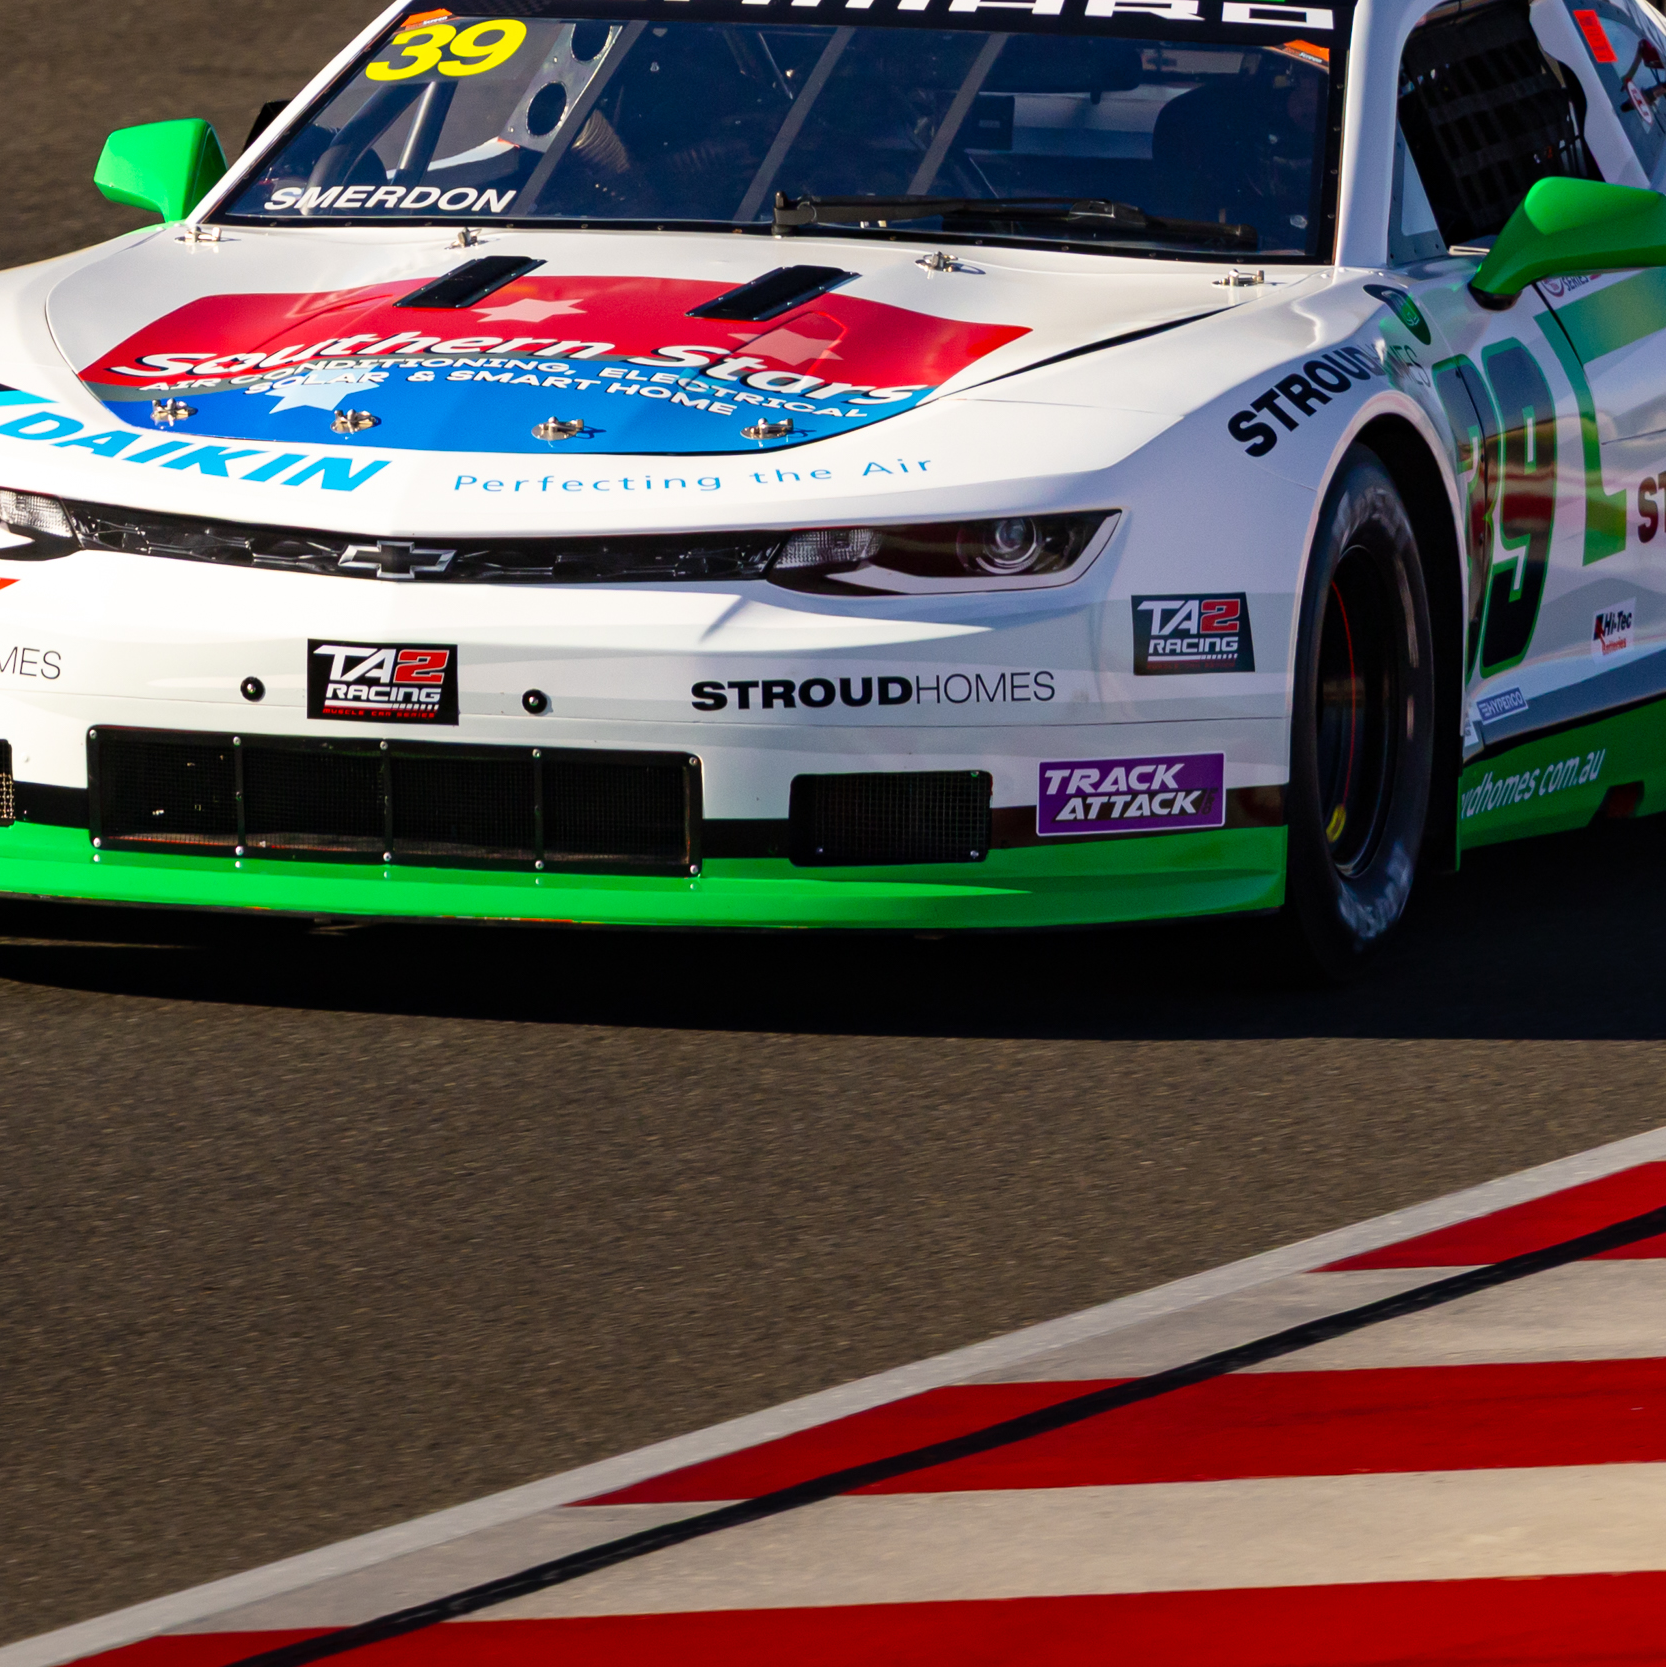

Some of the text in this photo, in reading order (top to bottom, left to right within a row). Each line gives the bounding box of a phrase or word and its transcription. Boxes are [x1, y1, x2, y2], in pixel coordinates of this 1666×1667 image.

[365, 19, 527, 81] 39
[264, 185, 517, 214] SMERDON
[109, 330, 930, 406] Southern Stars
[139, 357, 868, 418] AIR CONDITIONING, ELECTRICAL
[244, 369, 738, 417] SOLAR & SMART HOME
[454, 458, 932, 493] Perfecting the Air
[1137, 598, 1241, 636] TA2
[1148, 636, 1239, 654] RACING
[313, 644, 450, 685] TA2
[325, 683, 442, 703] RACING
[1044, 763, 1186, 796] TRACK
[1054, 789, 1203, 822] ATTACK
